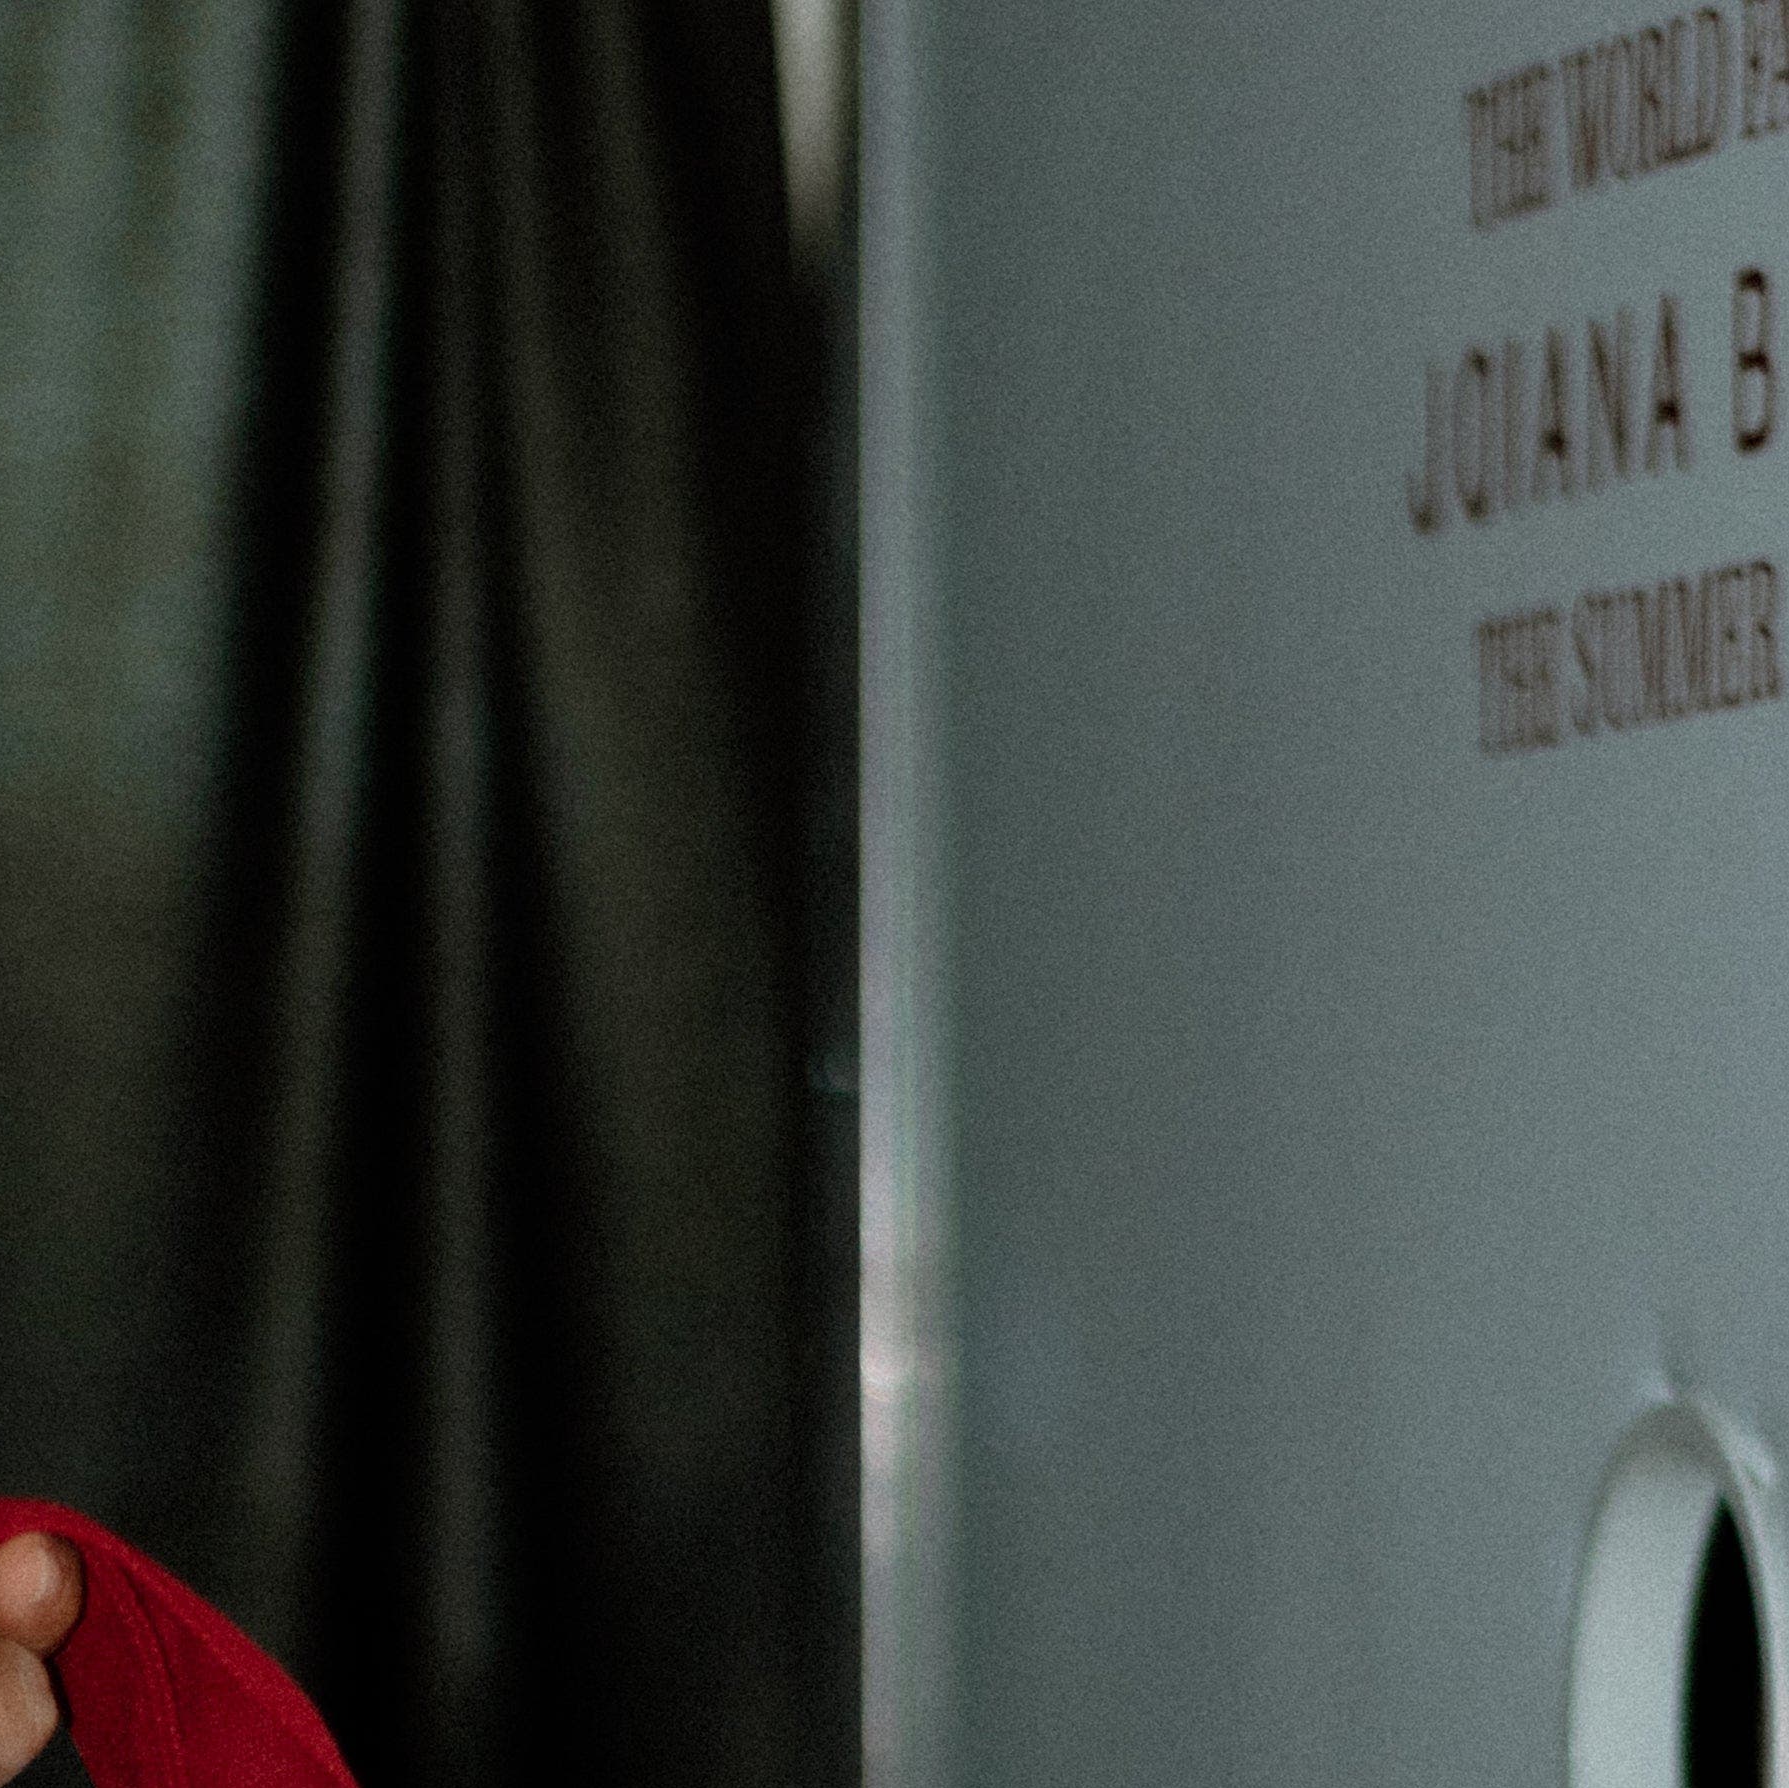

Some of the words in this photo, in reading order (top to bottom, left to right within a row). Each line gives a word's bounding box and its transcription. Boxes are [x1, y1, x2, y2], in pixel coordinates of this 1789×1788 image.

[1466, 64, 1553, 232] THE
[1561, 7, 1728, 190] WORLD
[1410, 292, 1694, 535] JOIANA
[1731, 267, 1775, 454] B
[1476, 604, 1565, 755] THE
[1571, 558, 1780, 735] SUMMER
